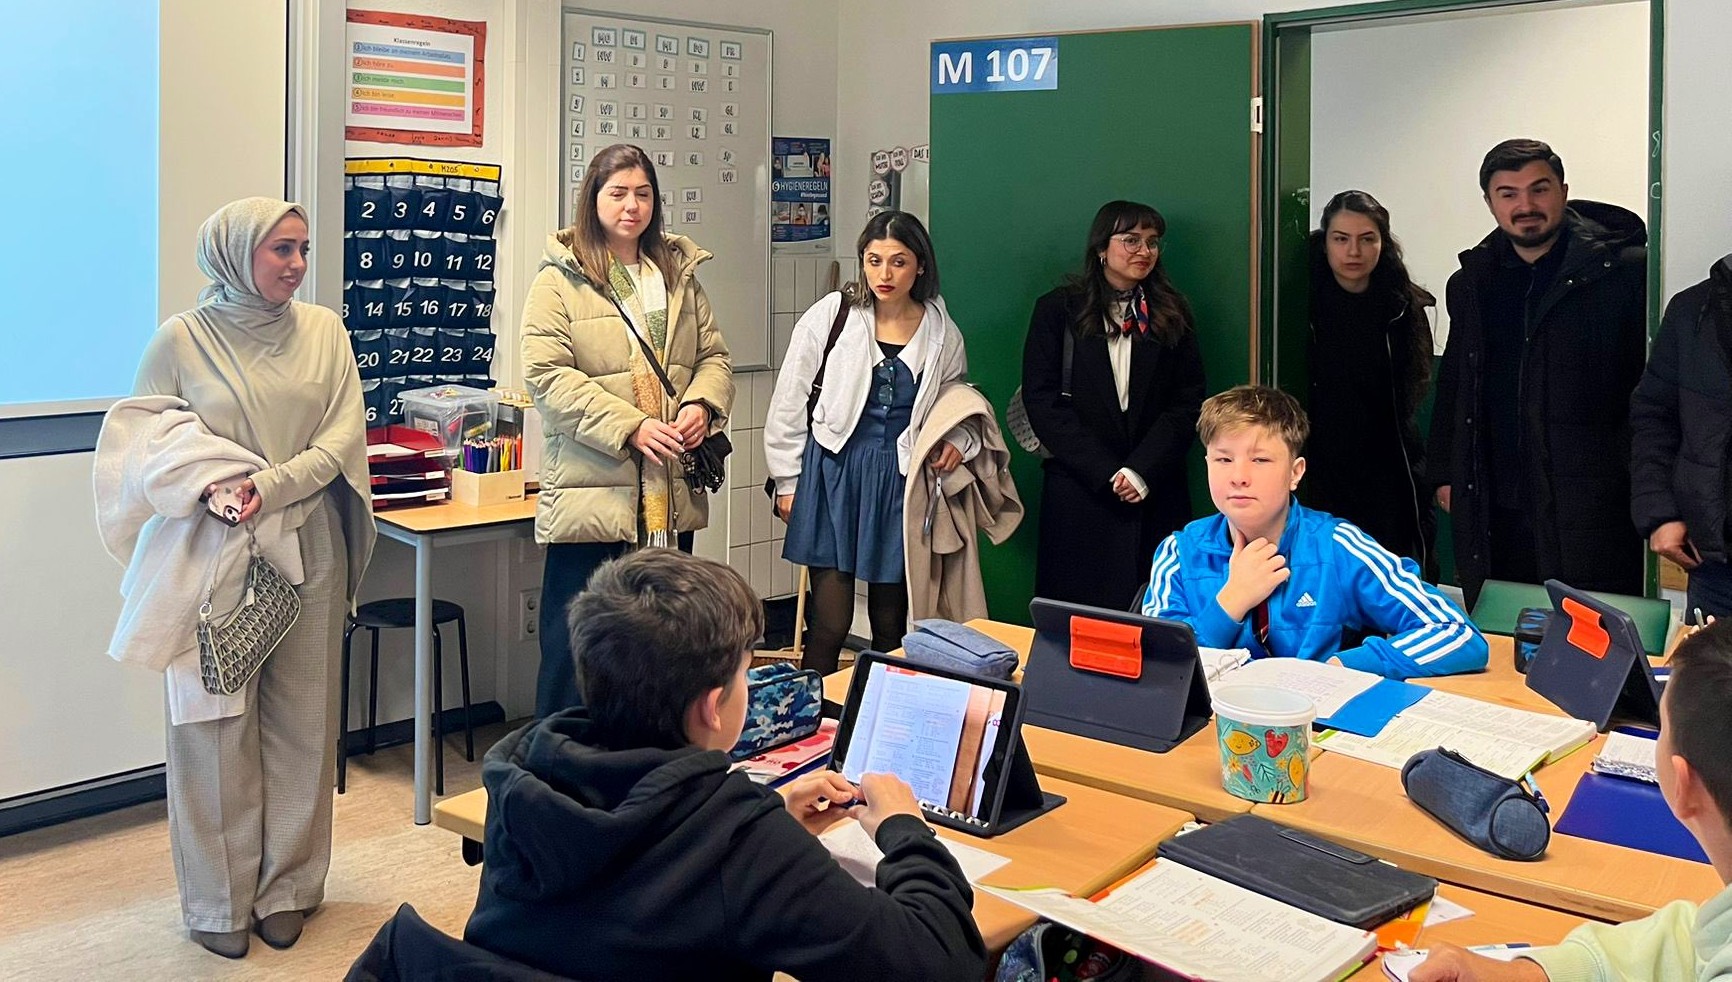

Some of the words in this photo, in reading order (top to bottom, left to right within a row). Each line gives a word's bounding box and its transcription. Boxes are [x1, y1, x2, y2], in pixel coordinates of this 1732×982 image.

[598, 33, 610, 44] MO
[938, 52, 972, 84] M
[986, 48, 1052, 82] 107
[658, 154, 666, 165] LZ
[914, 149, 924, 158] DAS
[781, 181, 828, 190] HYGIENEREGELN
[361, 202, 376, 218] 2
[394, 202, 407, 218] 3
[422, 202, 436, 217] 4
[453, 205, 466, 220] 5
[482, 210, 495, 224] 6
[360, 252, 373, 268] 8
[392, 254, 405, 269] 9
[414, 251, 432, 267] 10
[446, 255, 463, 270] 11
[474, 254, 492, 270] 12
[364, 302, 384, 317] 14
[394, 302, 413, 316] 15
[420, 300, 438, 315] 16
[449, 303, 468, 317] 17
[475, 303, 492, 317] 18
[358, 352, 380, 368] 20
[389, 349, 410, 364] 21
[412, 347, 434, 362] 22
[441, 347, 462, 362] 23
[472, 346, 493, 362] 24
[365, 406, 377, 421] 6
